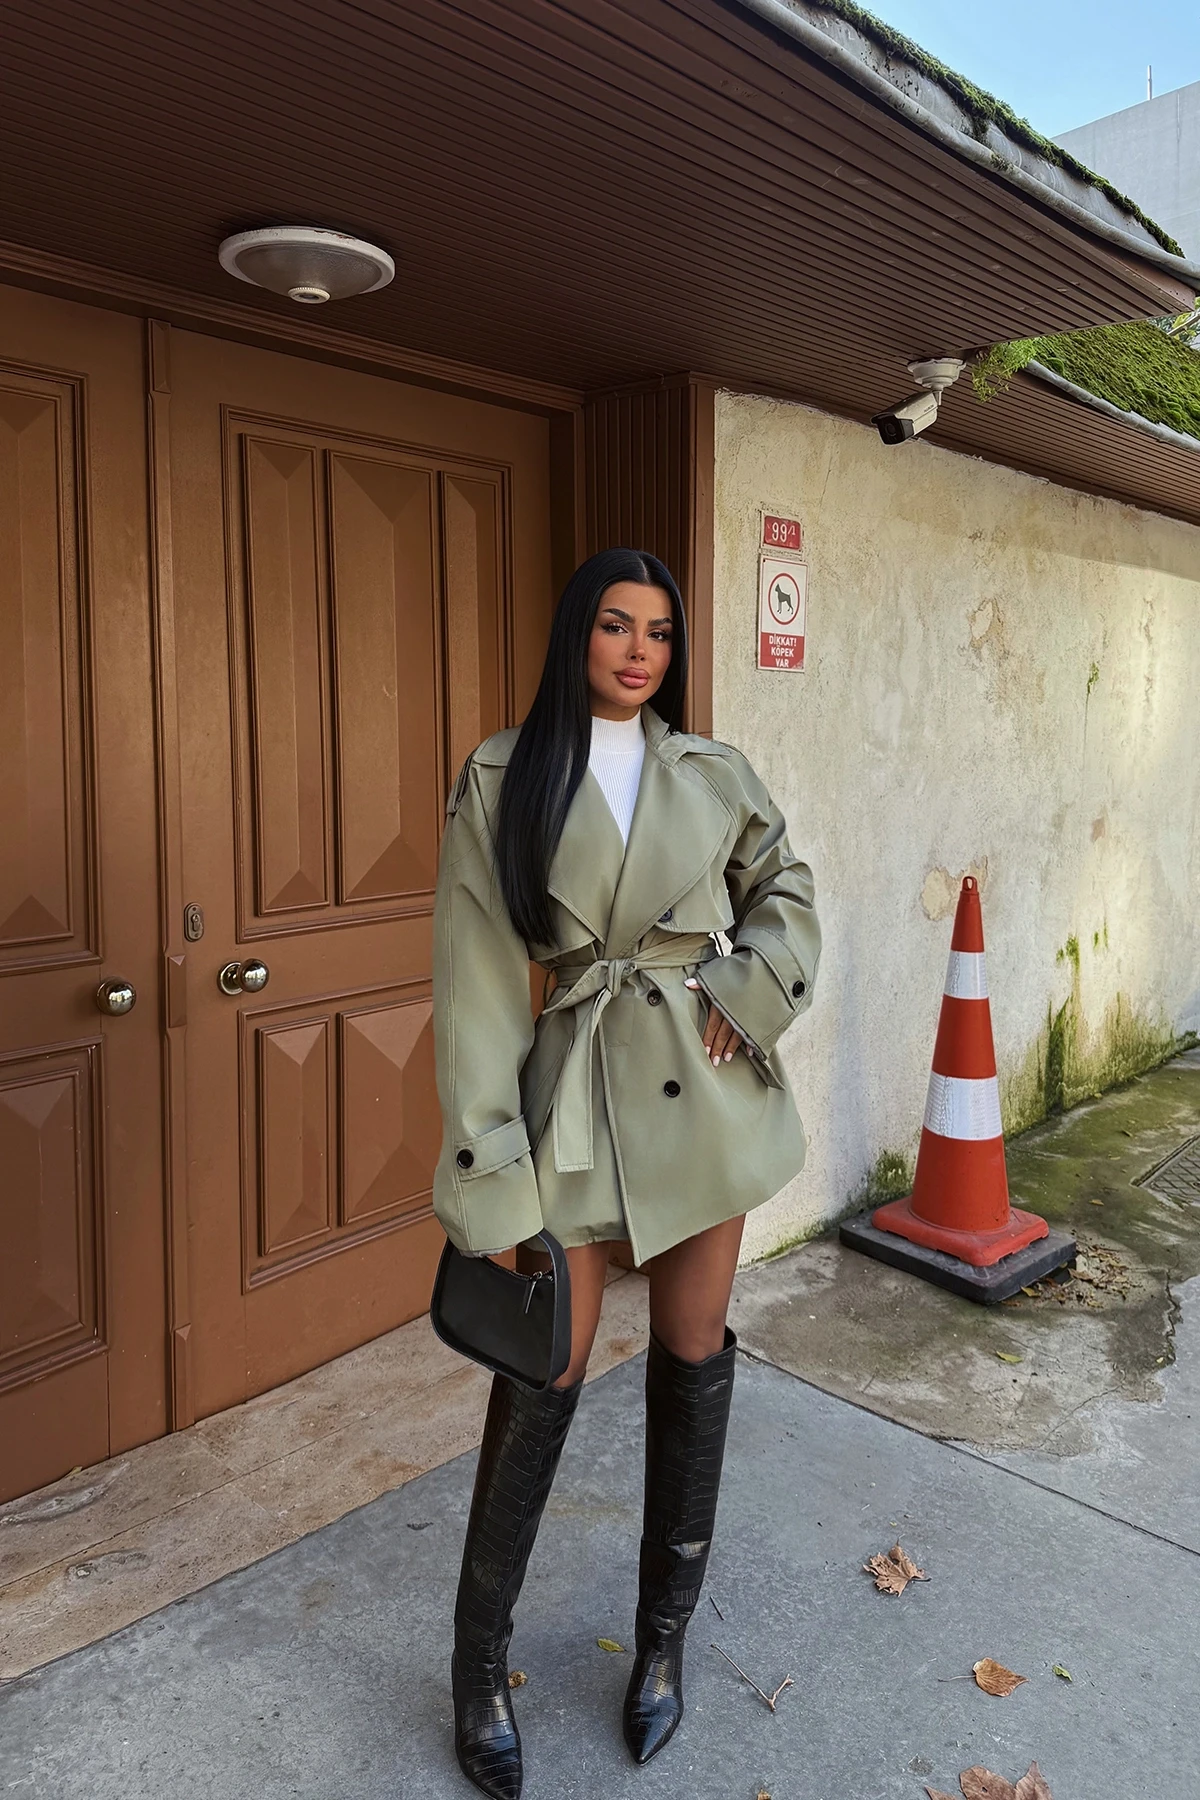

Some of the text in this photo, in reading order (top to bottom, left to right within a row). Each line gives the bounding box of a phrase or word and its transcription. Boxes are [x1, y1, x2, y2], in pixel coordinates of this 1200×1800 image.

[769, 634, 797, 647] DİKKAT!
[771, 645, 795, 658] KÖPEK
[775, 658, 790, 668] VAR
